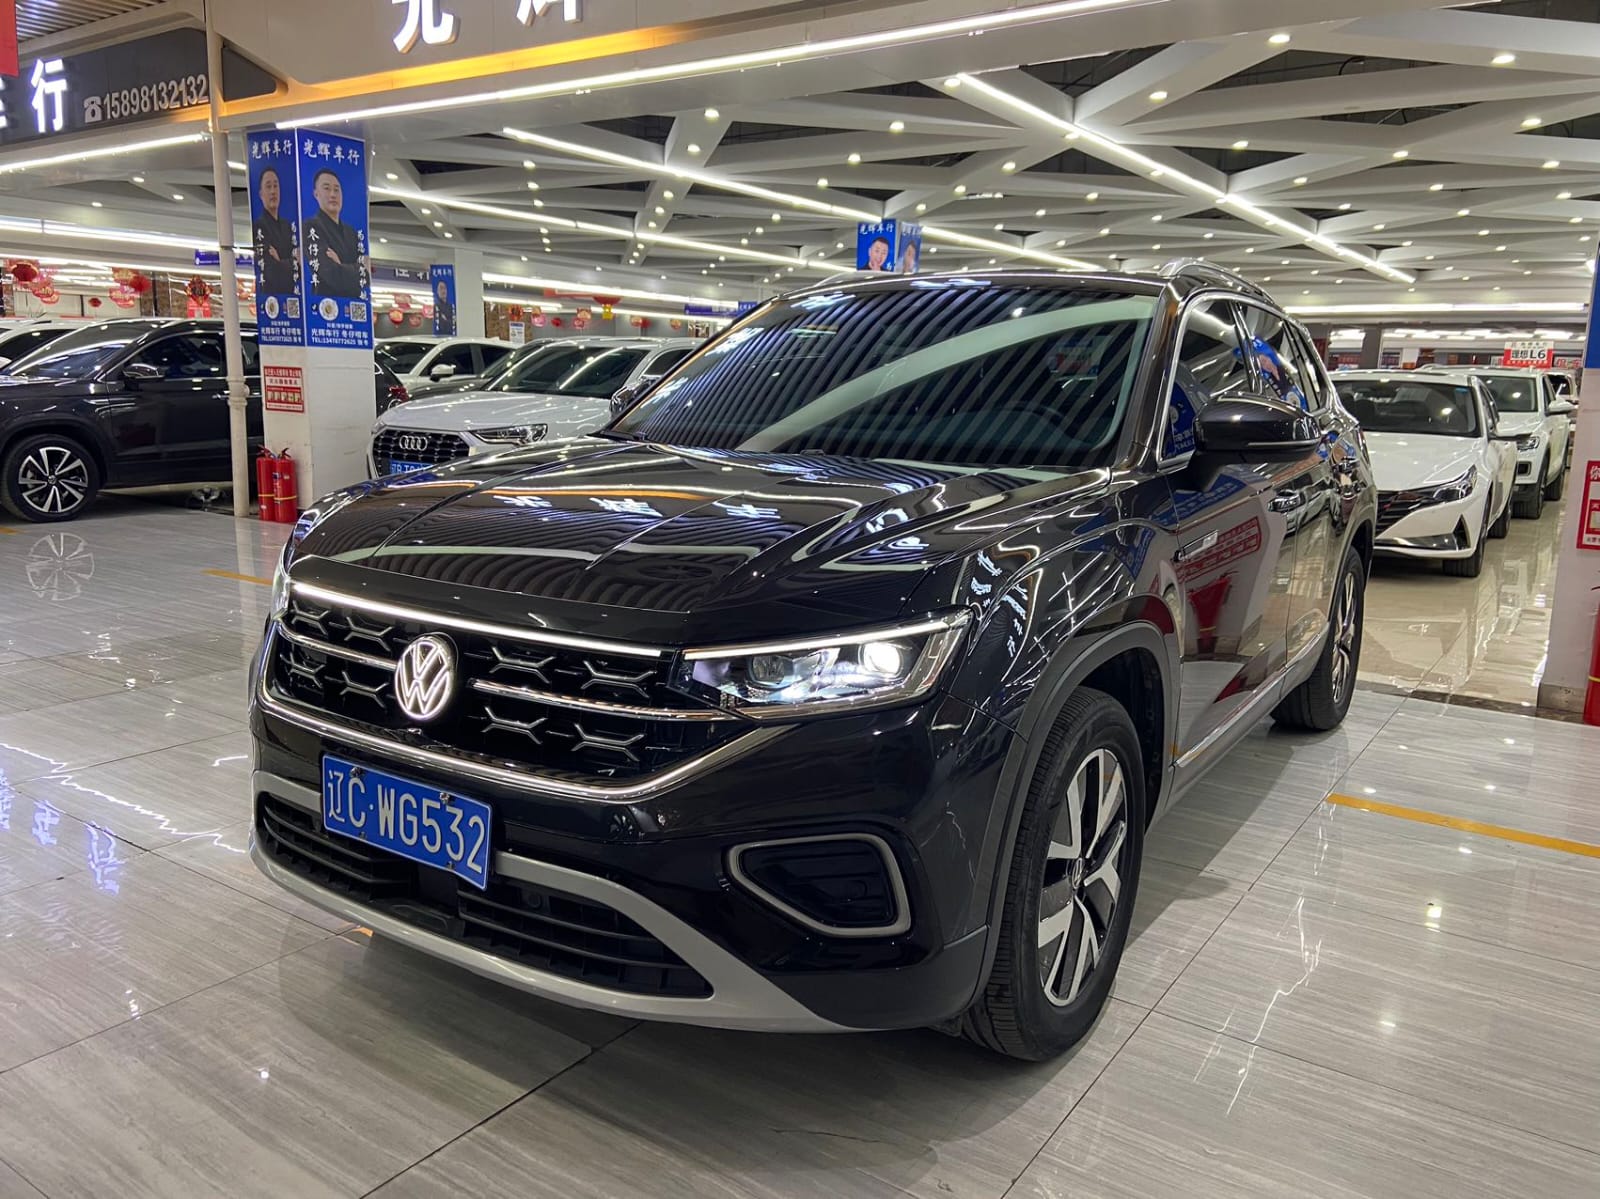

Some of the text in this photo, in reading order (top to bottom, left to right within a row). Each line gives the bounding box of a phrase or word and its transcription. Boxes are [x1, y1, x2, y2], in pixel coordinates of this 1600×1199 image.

[104, 74, 208, 120] 15898132132
[252, 139, 293, 159] 光辉车行
[303, 139, 360, 166] 光辉车行
[328, 769, 485, 874] 辽C·WG532
